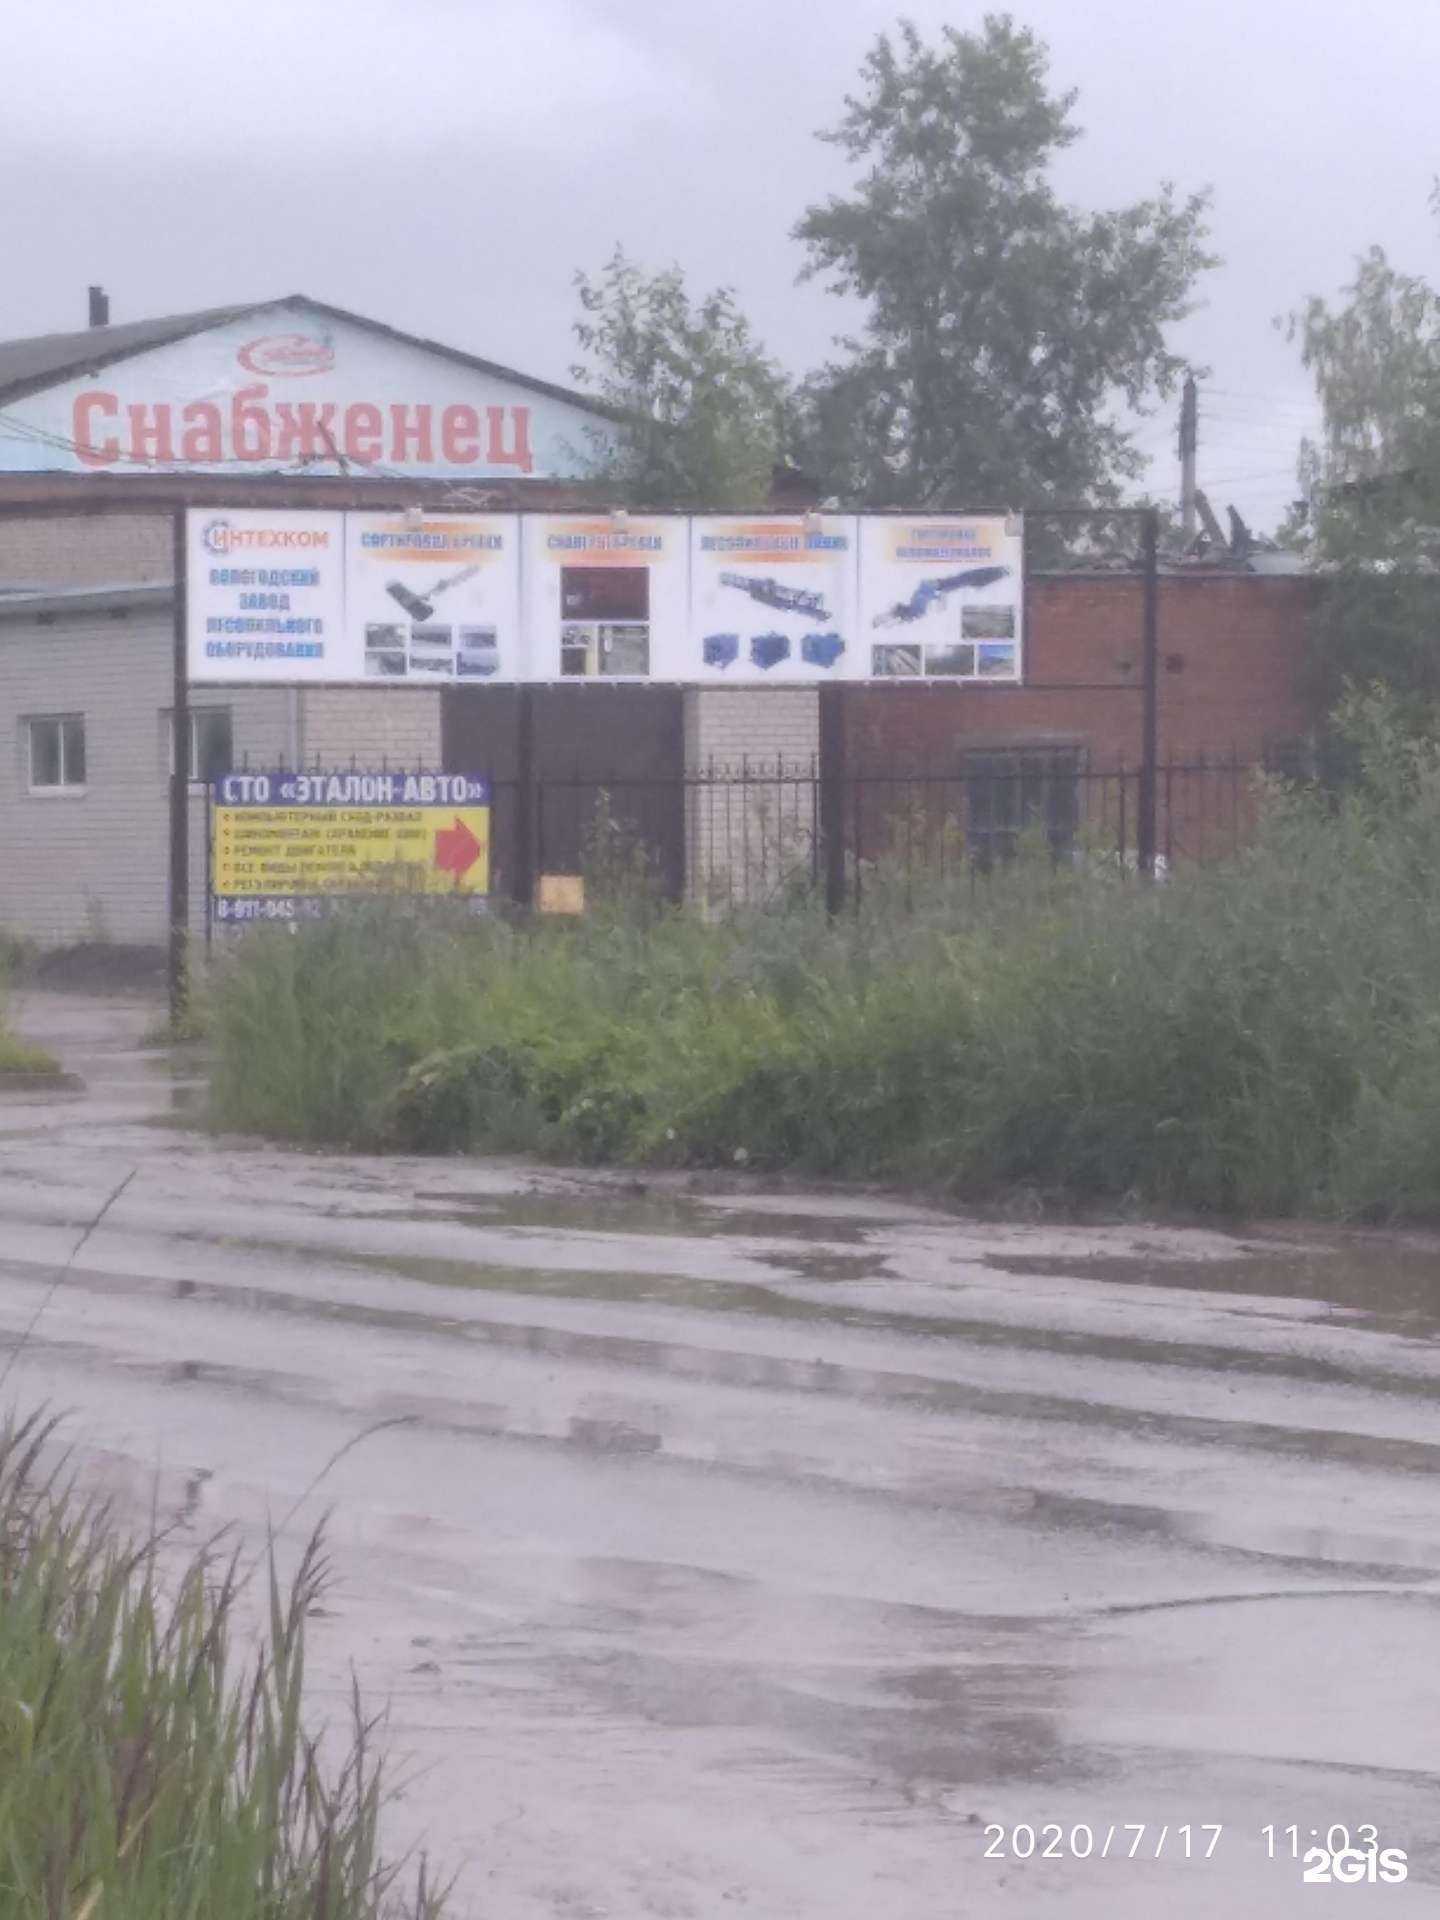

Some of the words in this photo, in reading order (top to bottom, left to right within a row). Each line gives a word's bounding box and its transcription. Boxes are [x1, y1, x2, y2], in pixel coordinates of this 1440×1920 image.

[71, 382, 534, 474] Снабженец
[212, 527, 329, 549] ИНТЕХКОМ
[239, 592, 291, 611] ЗАВОД
[222, 775, 270, 802] СТО
[279, 775, 484, 802] «ЭТАЛОН-АВТО»
